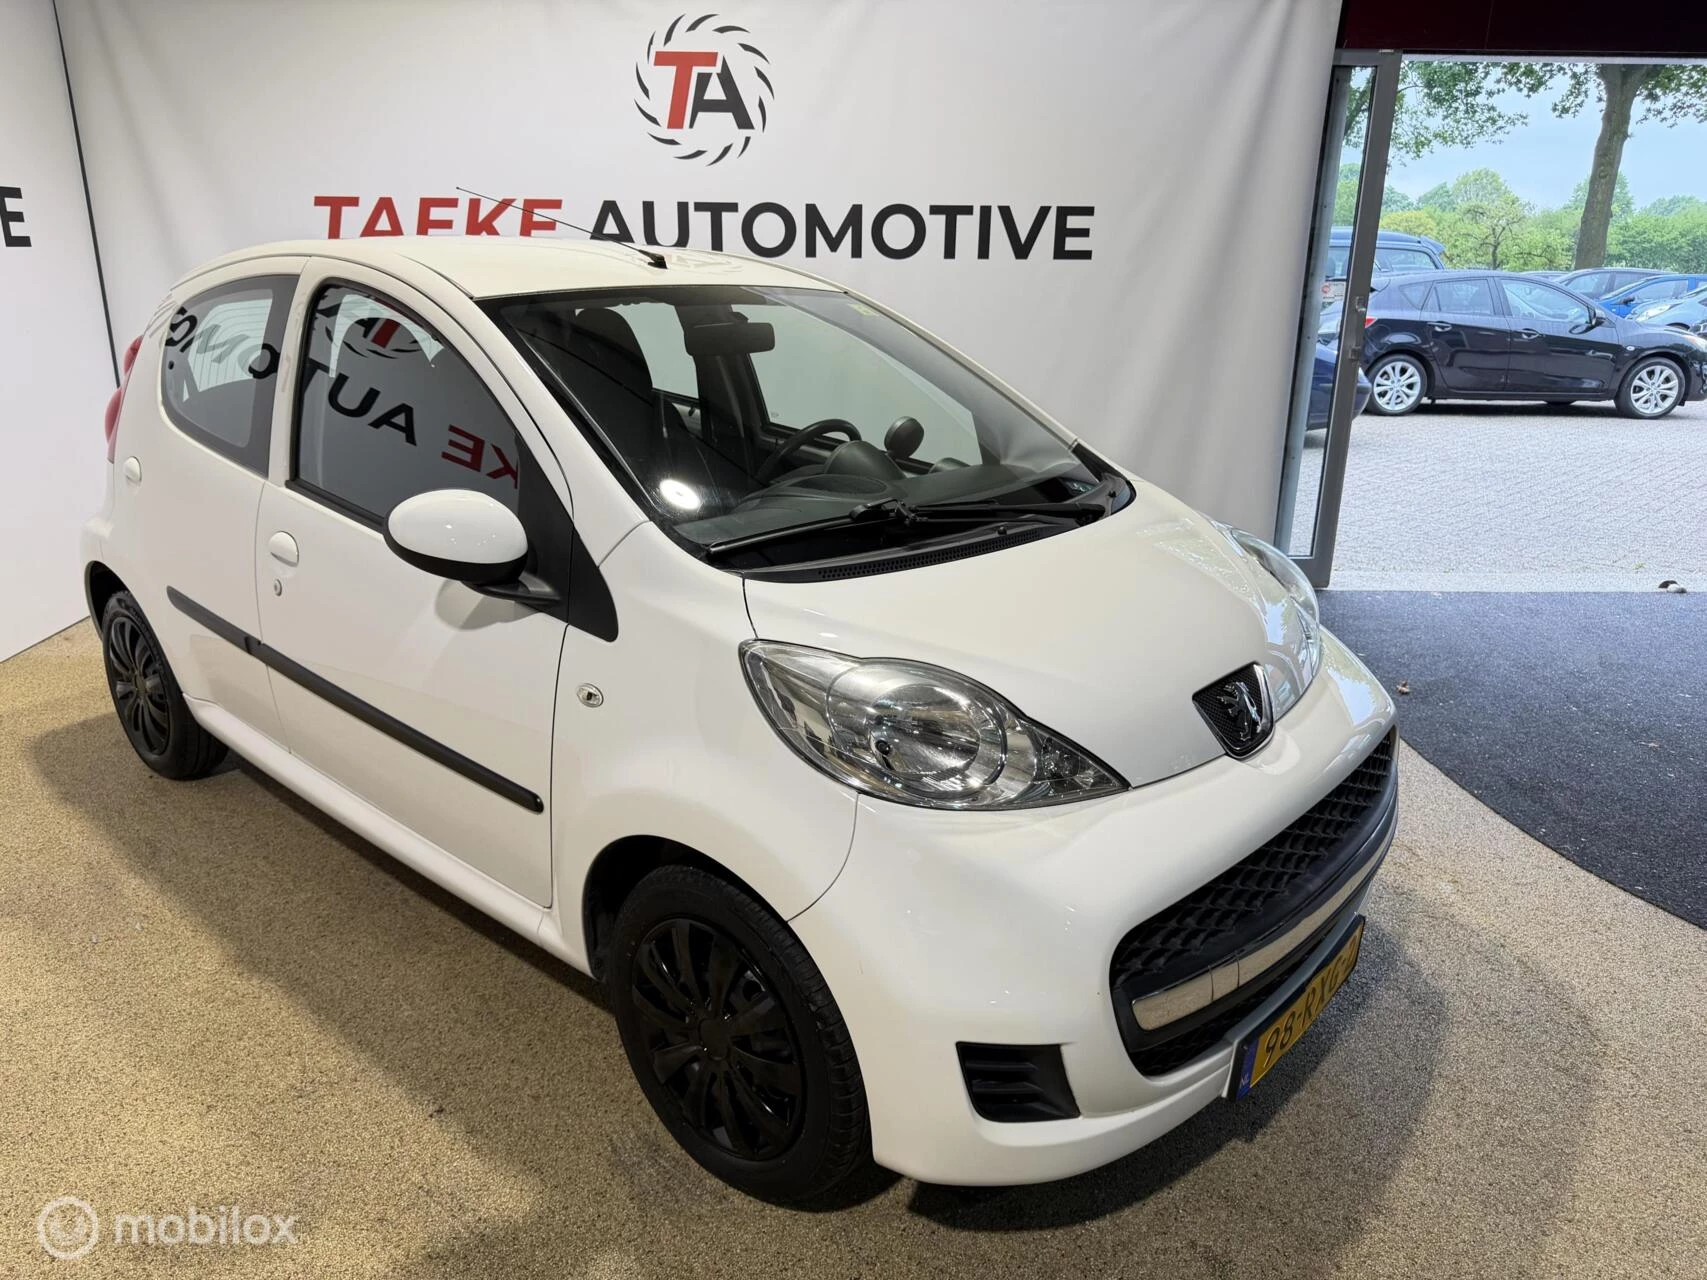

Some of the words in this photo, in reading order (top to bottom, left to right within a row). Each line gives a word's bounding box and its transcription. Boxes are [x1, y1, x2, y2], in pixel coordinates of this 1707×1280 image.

[653, 51, 755, 129] TA
[314, 196, 562, 239] TAEKE
[590, 199, 1095, 260] AUTOMOTIVE
